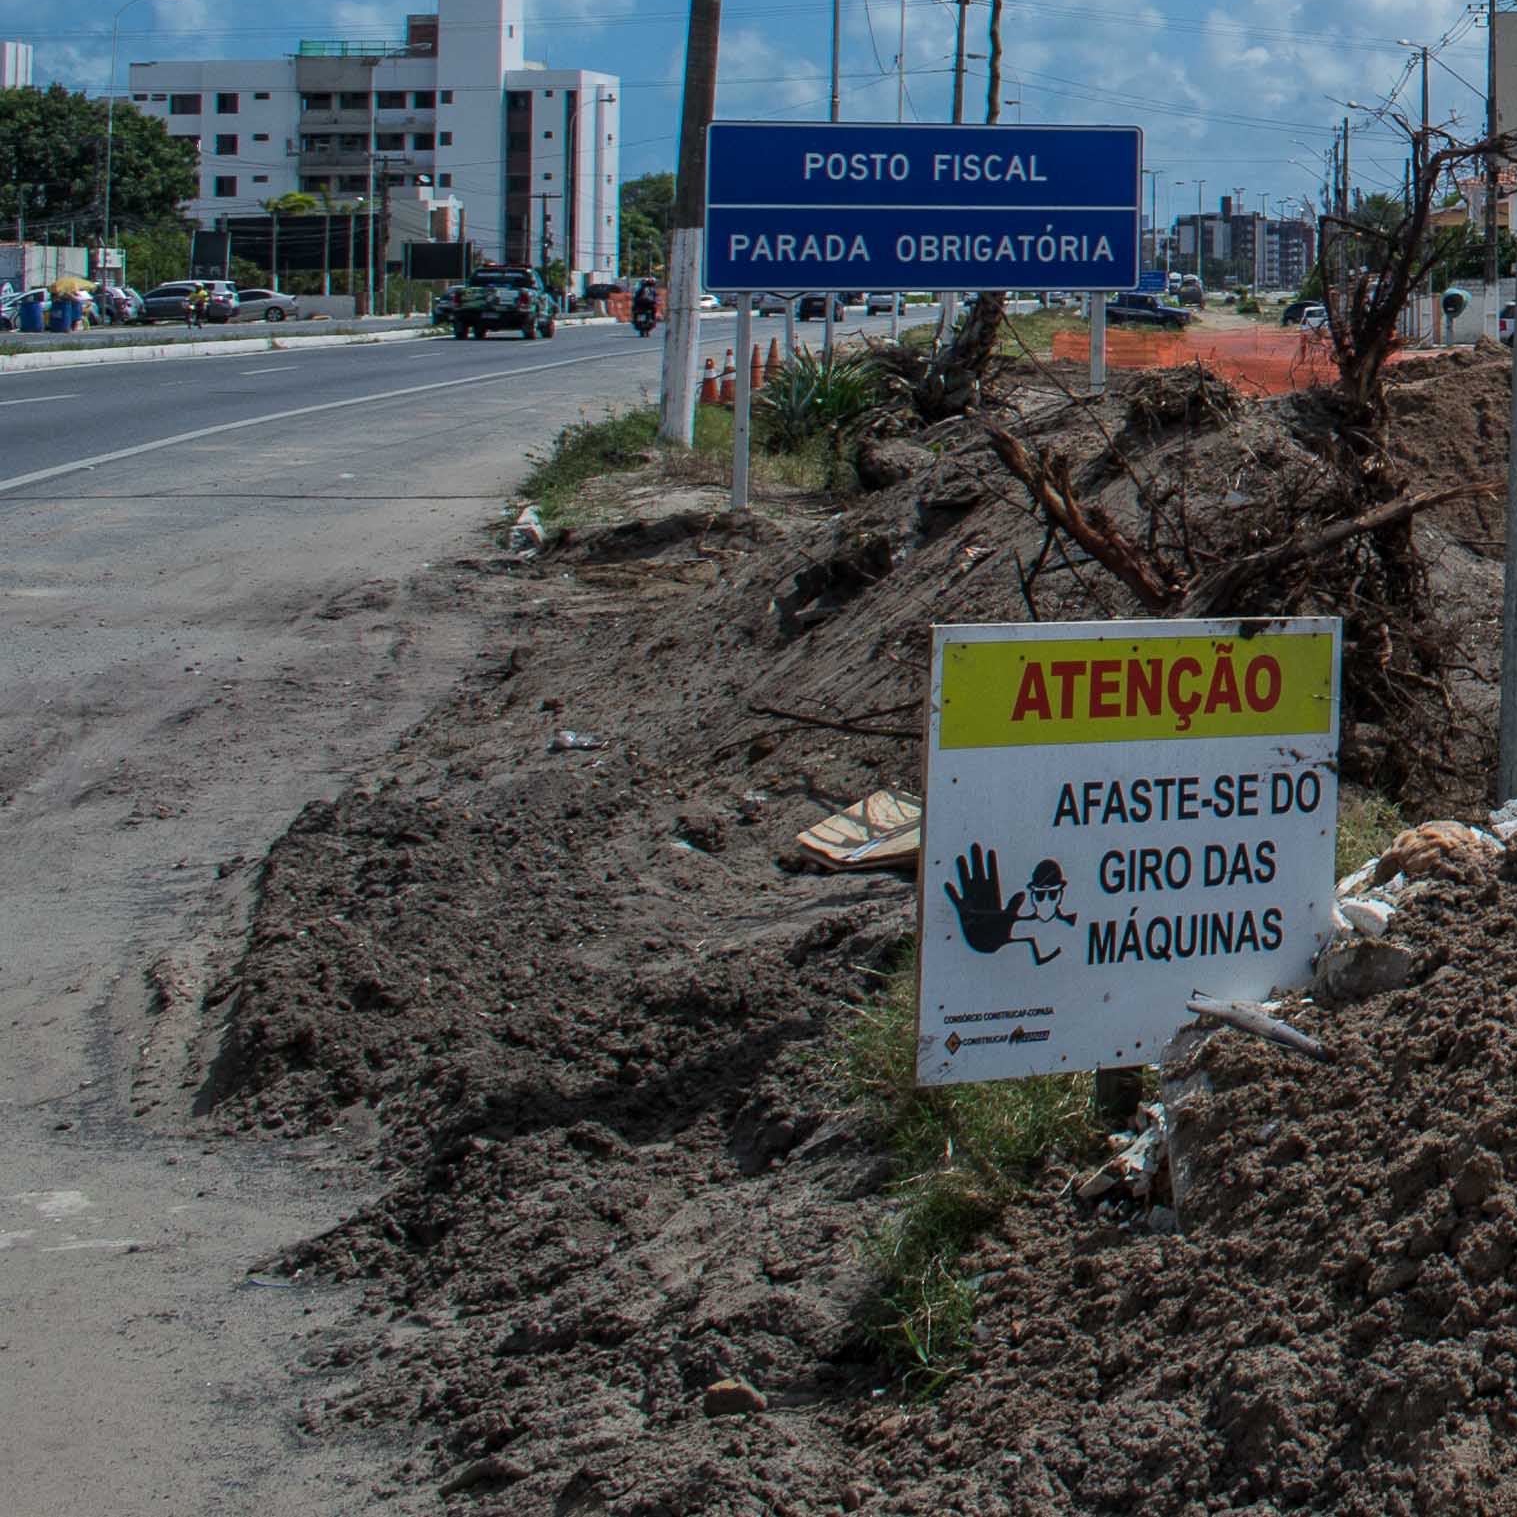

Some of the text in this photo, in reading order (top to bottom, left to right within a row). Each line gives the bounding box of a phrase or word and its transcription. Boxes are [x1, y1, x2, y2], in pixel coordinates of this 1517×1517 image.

[804, 153, 1047, 181] POSTO FISCAL
[730, 224, 1114, 262] PARADA OBRIGATÓRIA
[1011, 643, 1282, 731] ATENÇÃO
[1053, 770, 1321, 827] AFASTE-SE DO
[1099, 840, 1276, 894] GIRO DAS
[1087, 906, 1283, 966] MÁQUINAS
